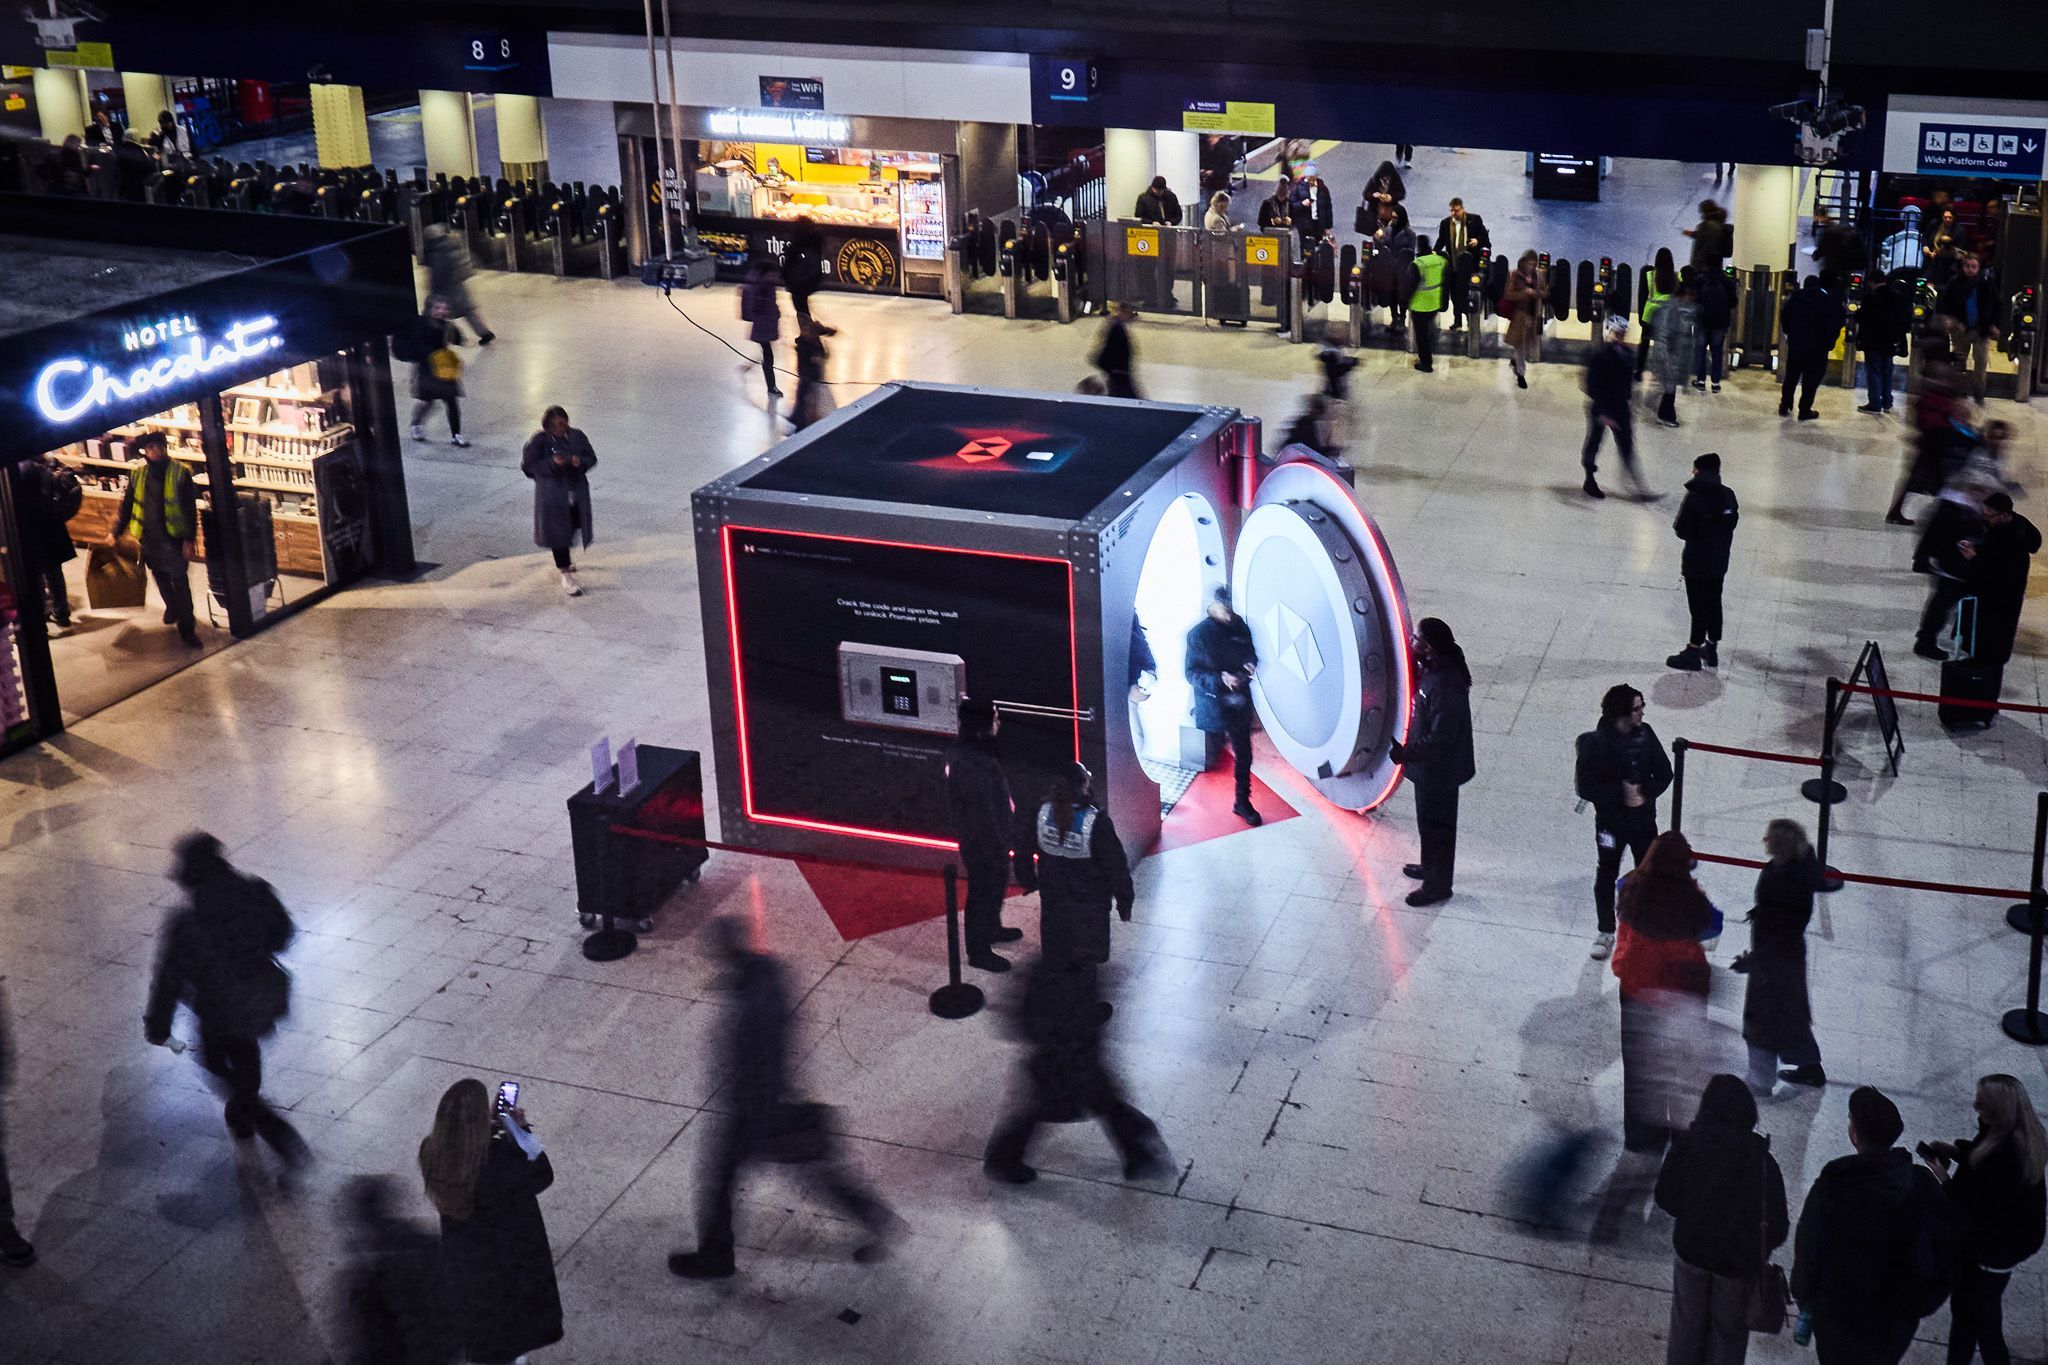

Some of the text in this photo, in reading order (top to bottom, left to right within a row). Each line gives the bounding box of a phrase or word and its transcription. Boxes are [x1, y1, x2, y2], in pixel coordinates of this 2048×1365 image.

[472, 40, 484, 60] 8
[501, 38, 510, 58] 8
[1061, 68, 1076, 90] 9
[1091, 66, 1097, 88] 9
[1924, 155, 2008, 168] Wide Platform Gate
[124, 315, 197, 351] HOTEL
[836, 598, 858, 607] Crack
[907, 607, 926, 615] open
[863, 610, 887, 618] unlock
[889, 612, 917, 621] Premier
